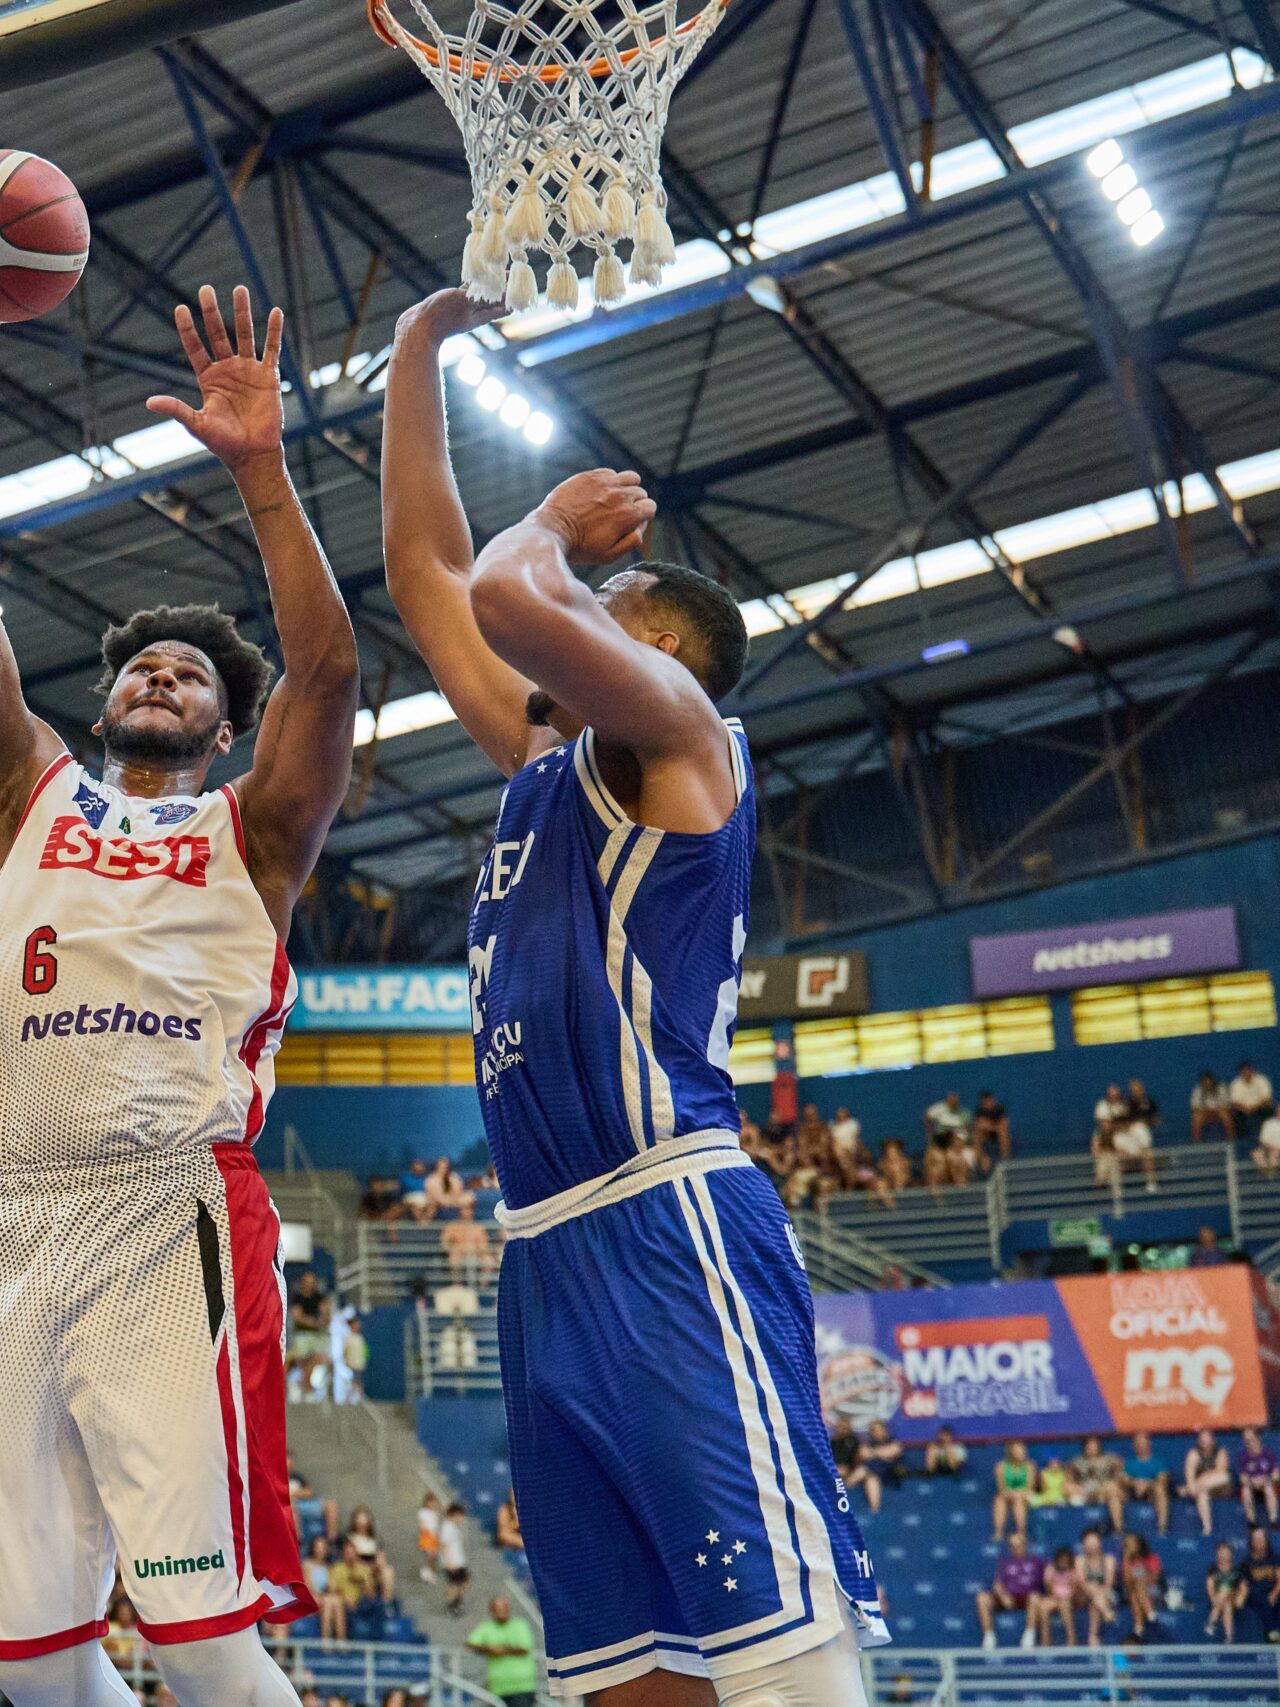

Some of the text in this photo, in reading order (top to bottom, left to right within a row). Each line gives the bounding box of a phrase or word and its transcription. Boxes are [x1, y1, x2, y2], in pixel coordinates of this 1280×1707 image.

[56, 823, 193, 876] SESI
[22, 925, 57, 995] 6
[301, 975, 467, 1013] Uni-FAC
[21, 1003, 202, 1042] netshoes
[1111, 1276, 1205, 1310] LOJA
[1109, 1307, 1228, 1340] OFICIAL
[904, 1341, 1054, 1386] MAIOR
[937, 1379, 1069, 1419] BRASIL
[134, 1549, 225, 1578] Unimed
